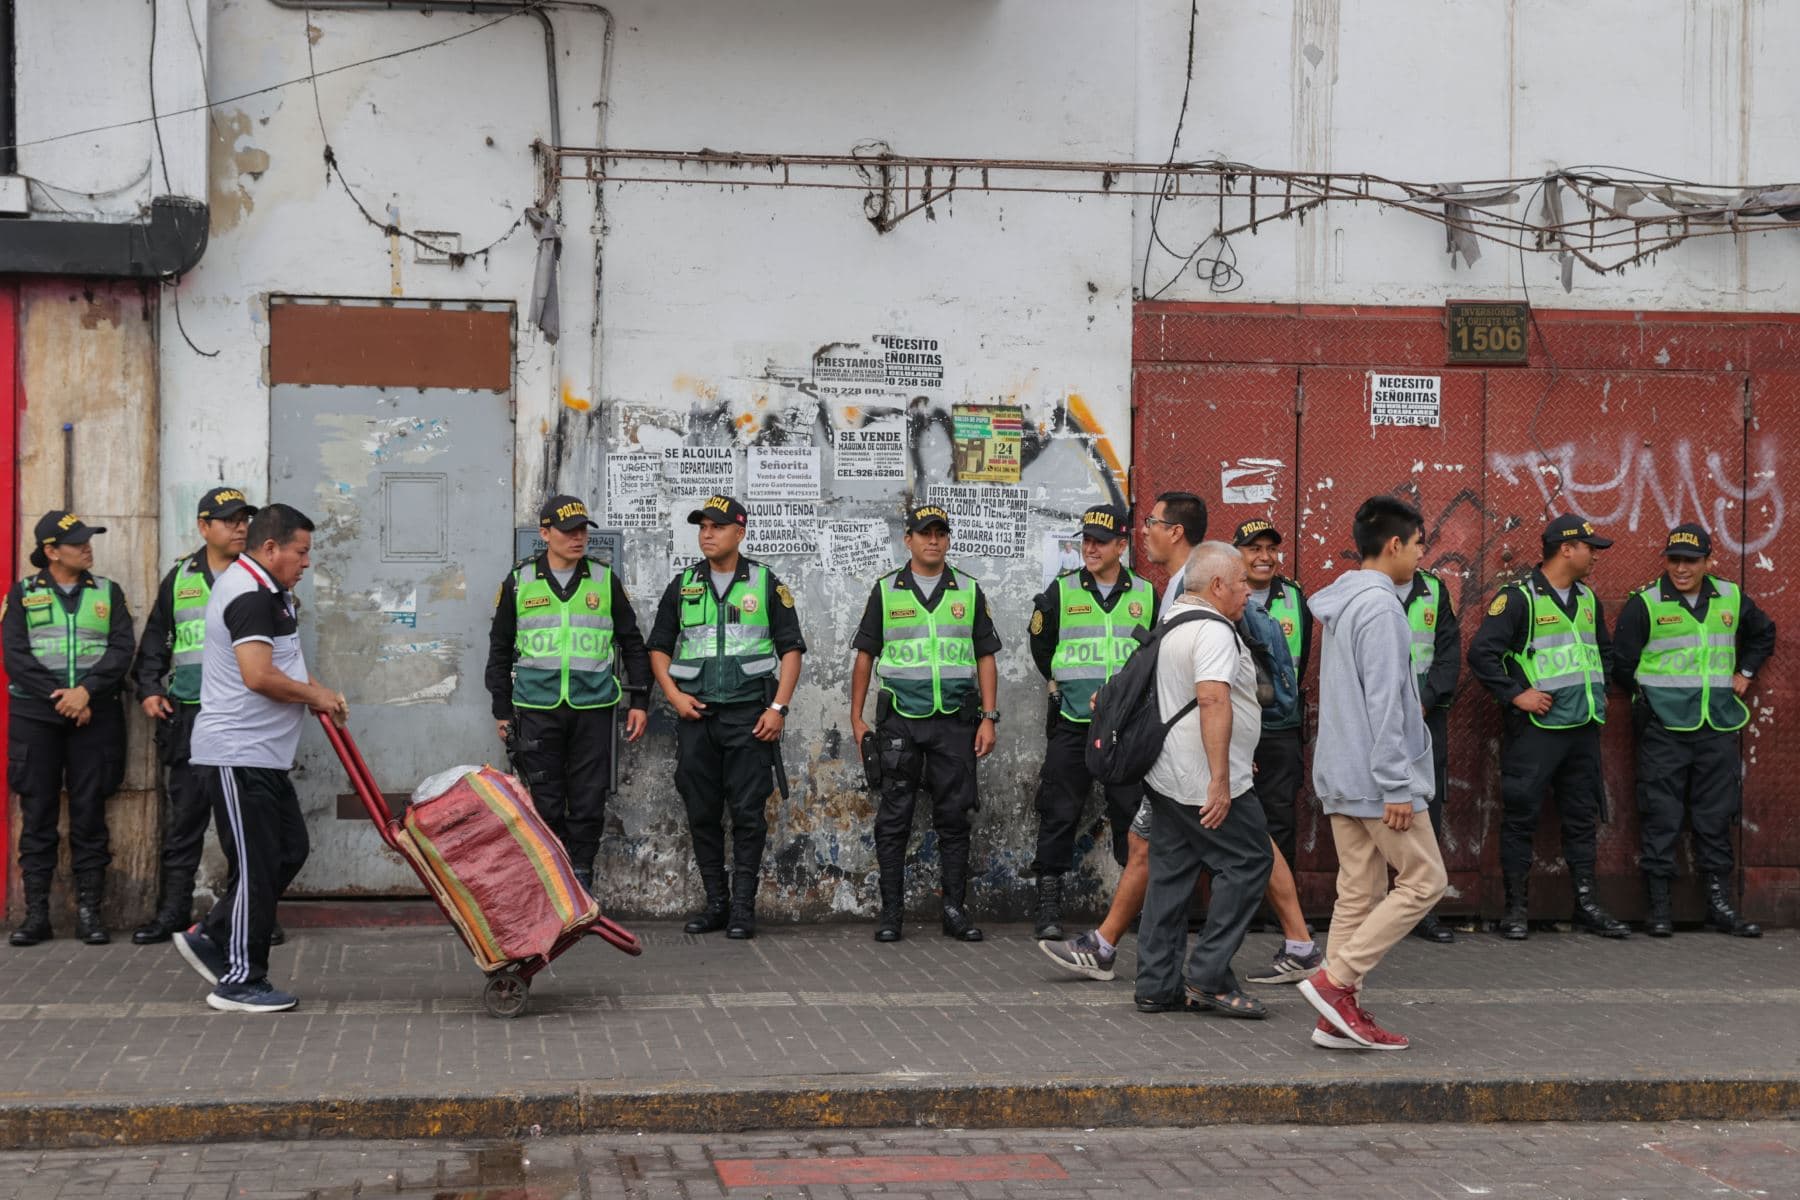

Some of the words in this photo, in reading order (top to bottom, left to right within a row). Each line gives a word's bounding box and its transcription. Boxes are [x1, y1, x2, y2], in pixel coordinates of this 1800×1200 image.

[1456, 325, 1522, 352] 1506
[816, 358, 884, 368] PRESTAMOS
[884, 350, 942, 365] EÑORITAS
[884, 378, 896, 386] 20
[898, 378, 918, 386] 258
[920, 379, 942, 388] 580
[1379, 377, 1434, 390] NECESITO
[1374, 390, 1438, 403] SEÑORITAS
[1396, 416, 1415, 424] 258
[840, 432, 856, 442] SE
[860, 432, 901, 442] VENDE
[756, 448, 768, 456] Se
[770, 448, 812, 456] Necesita
[838, 442, 866, 450] MAQUINA
[868, 442, 874, 450] DE
[876, 442, 902, 450] COSTURA
[998, 442, 1013, 454] 24
[664, 448, 679, 458] SE
[682, 448, 732, 458] ALQUILA
[680, 462, 733, 474] DEPARTAMENTO
[760, 460, 808, 470] Señorita
[929, 486, 948, 498] LOTES
[950, 487, 966, 498] PARA
[968, 488, 976, 498] TU
[981, 488, 1000, 498] LOTES
[1002, 488, 1018, 498] PARA
[1020, 490, 1028, 499] TU
[704, 496, 730, 513] LICIA
[747, 504, 782, 516] ALQUILO
[784, 504, 814, 516] TIENDA
[946, 504, 981, 516] ALQUILO
[760, 519, 772, 528] PISO
[958, 519, 971, 527] PISO
[746, 530, 758, 541] JR.
[760, 529, 797, 541] GAMARRA
[958, 530, 993, 542] GAMARRA
[996, 532, 1012, 543] 1133
[1668, 532, 1700, 547] POLICIA
[951, 542, 1012, 555] 48020600
[522, 631, 610, 654] POLICIA
[888, 641, 975, 663] POLICIA
[1064, 641, 1136, 663] POLIC
